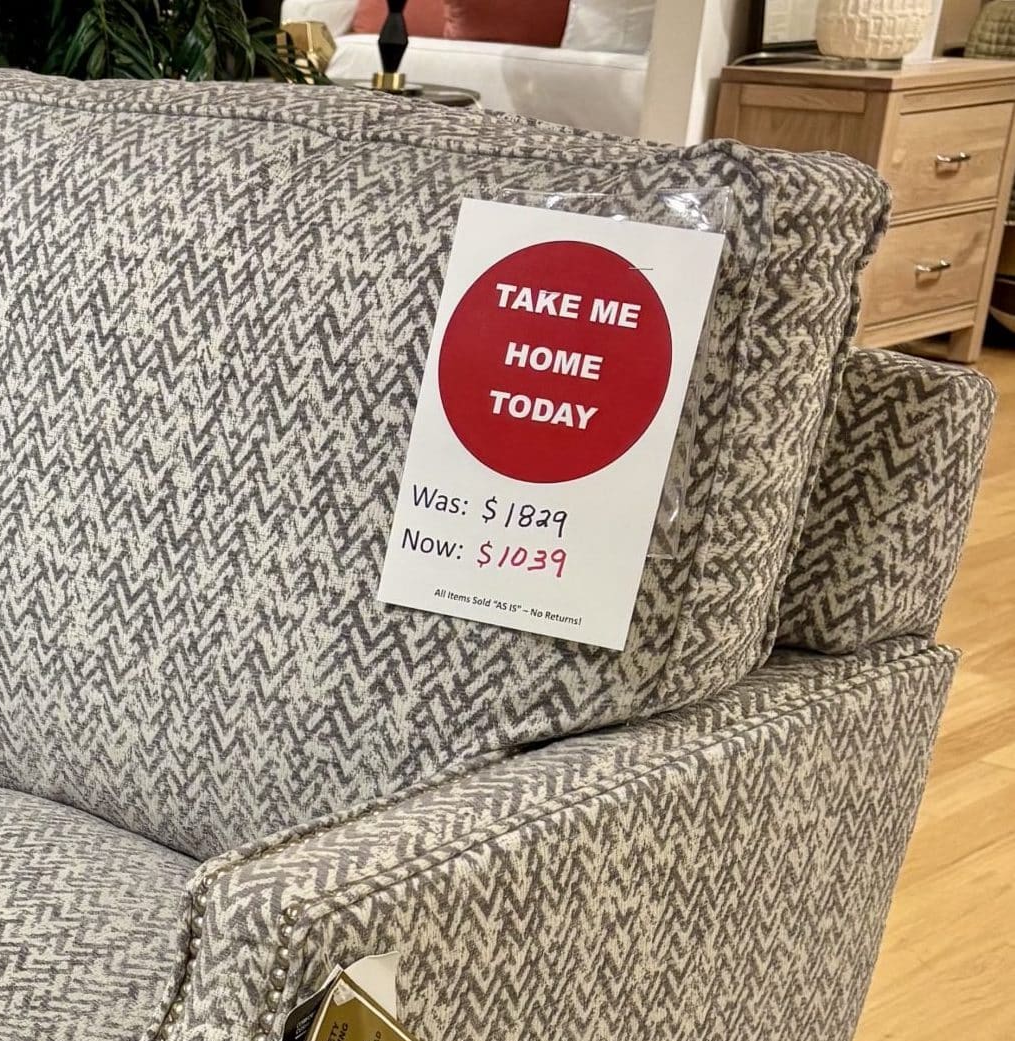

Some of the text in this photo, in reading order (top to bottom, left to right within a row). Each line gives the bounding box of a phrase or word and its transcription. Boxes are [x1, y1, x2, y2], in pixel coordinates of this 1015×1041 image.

[496, 283, 642, 329] TAKE ME
[504, 341, 604, 380] HOME
[489, 389, 598, 430] TODAY
[413, 484, 469, 516] Was:
[401, 527, 567, 578] Now: $1039
[434, 588, 446, 598] All
[447, 591, 471, 604] Items
[472, 596, 491, 608] Sold
[530, 608, 544, 618] No
[545, 611, 583, 626] Returns!
